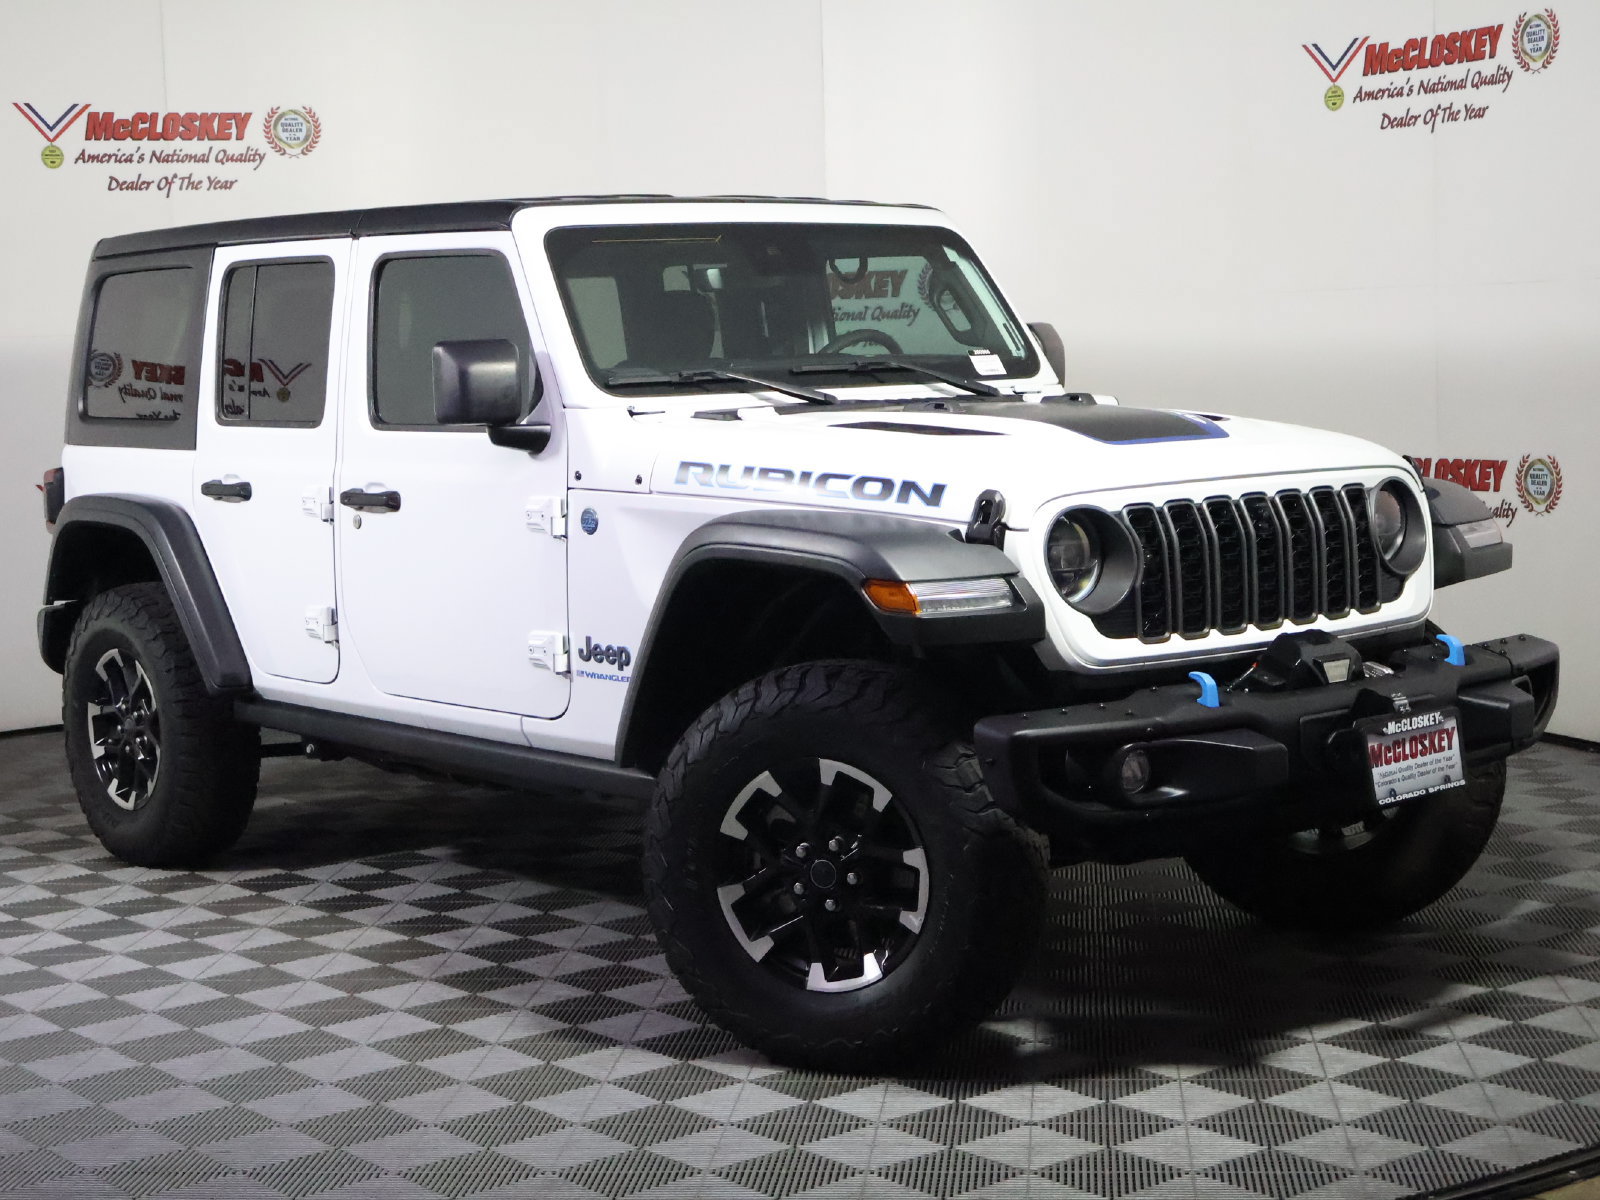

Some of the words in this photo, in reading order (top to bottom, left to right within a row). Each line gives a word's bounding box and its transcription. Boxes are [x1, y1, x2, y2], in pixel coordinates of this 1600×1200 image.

[1362, 24, 1504, 77] McCLOSKEY
[1353, 77, 1414, 104] America's
[1417, 71, 1468, 96] National
[1470, 65, 1514, 93] Quality
[85, 111, 253, 142] McCLOSKEY
[1380, 107, 1421, 130] Dealer
[1423, 105, 1440, 133] Of
[1440, 102, 1461, 124] The
[1463, 103, 1490, 122] Year
[74, 147, 145, 165] America's
[149, 148, 211, 165] National
[214, 146, 266, 171] Quality
[107, 175, 154, 192] Dealer
[157, 173, 177, 198] Of
[178, 174, 203, 191] The
[207, 175, 238, 191] Year
[871, 301, 921, 326] Quality
[674, 460, 948, 508] RUBICON
[577, 635, 632, 672] Jeep
[1387, 711, 1442, 735] McCLOSKEY
[1369, 726, 1456, 769] McCLOSKEY
[1378, 788, 1426, 806] COLORADO
[1427, 779, 1466, 794] SPRINGS
